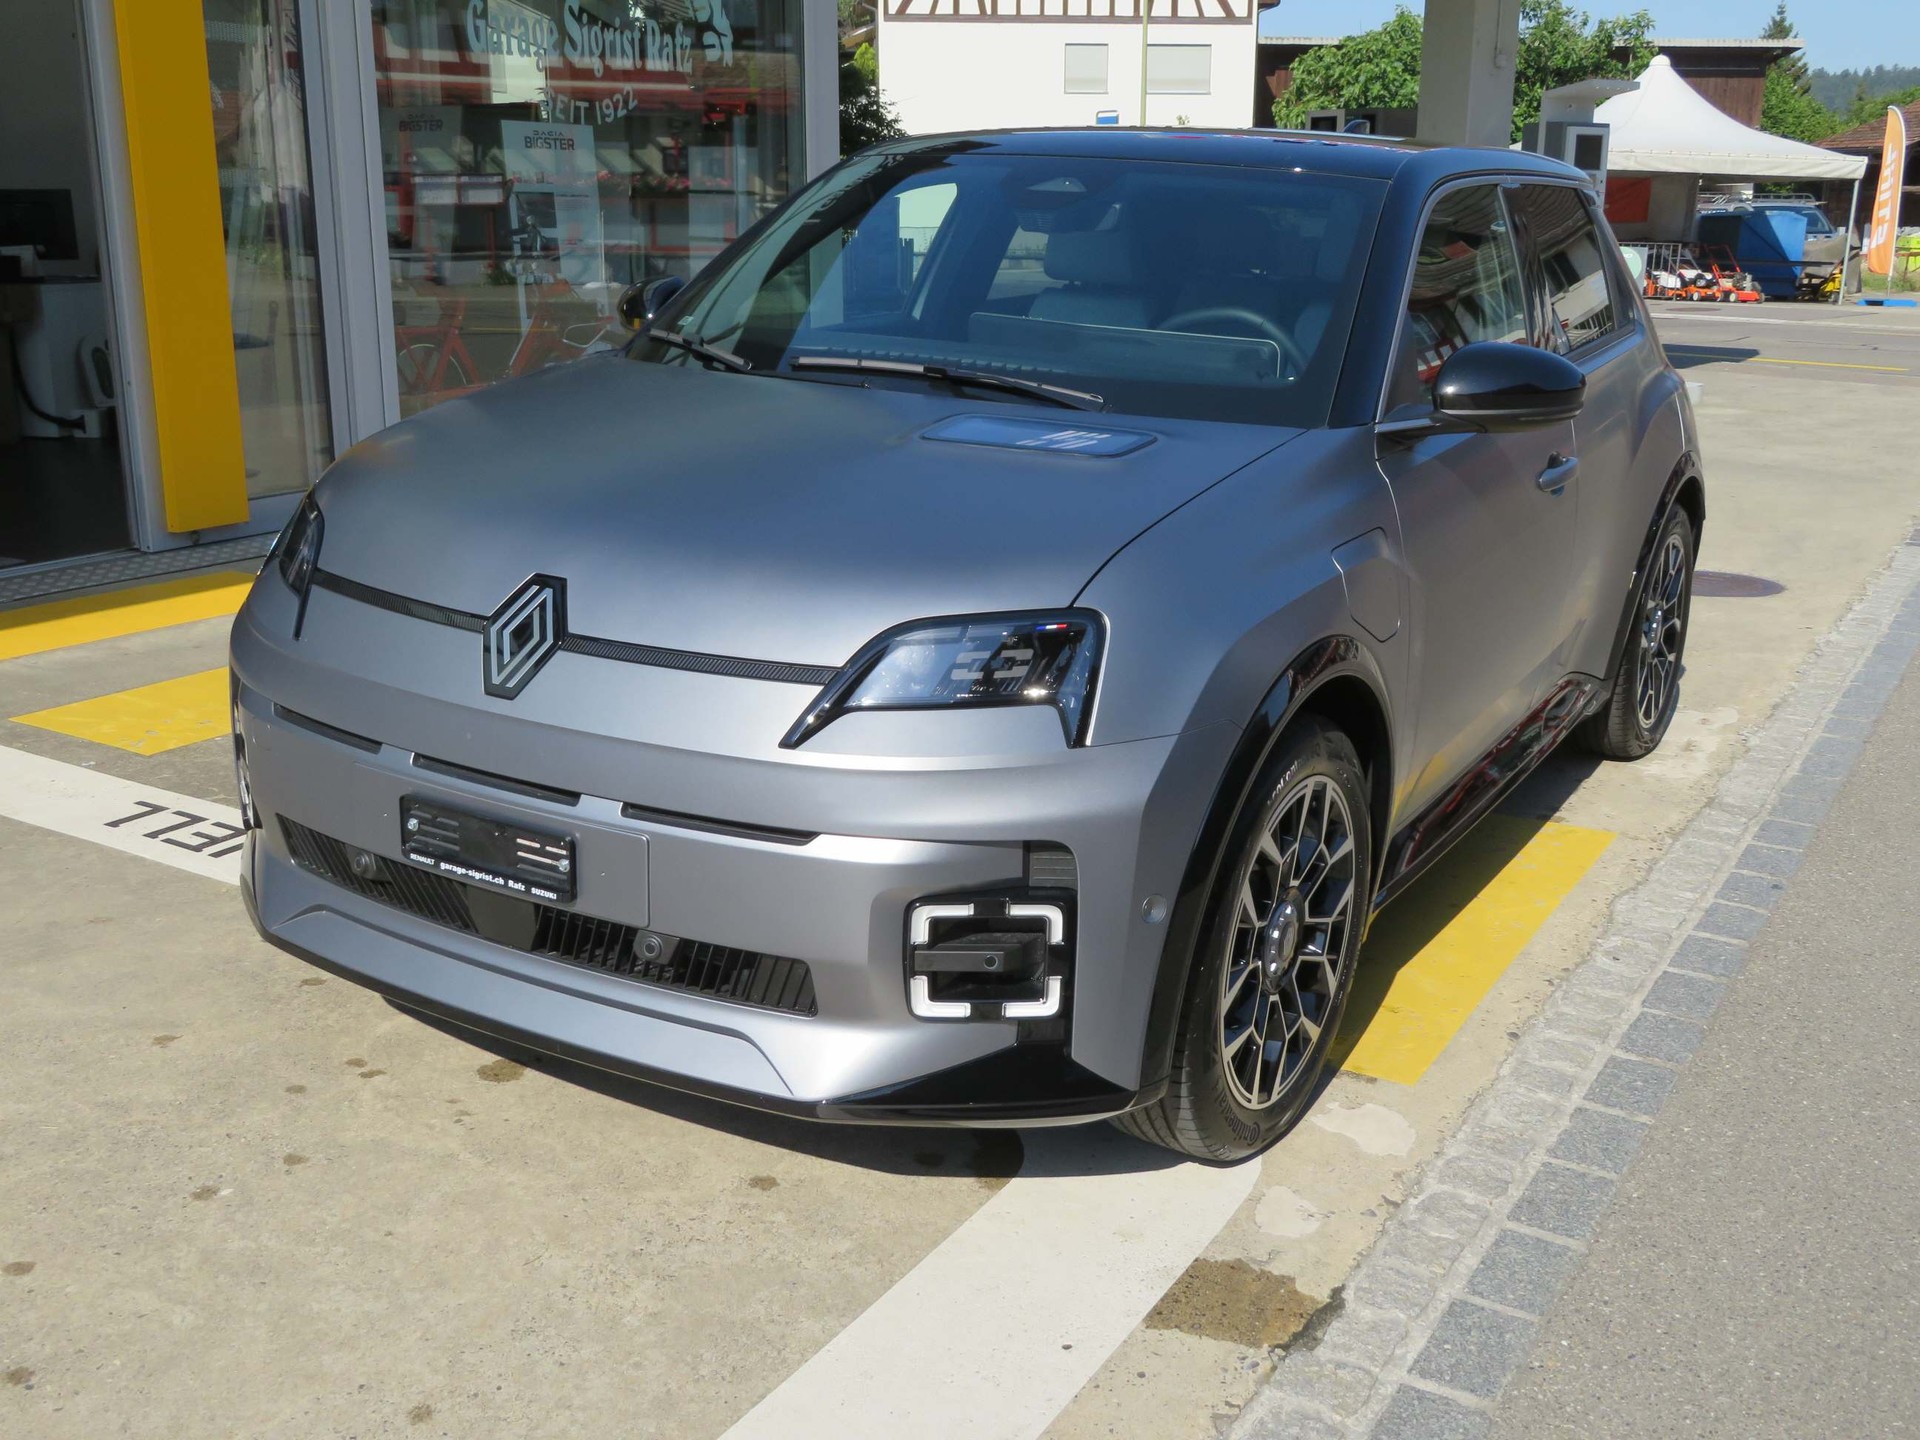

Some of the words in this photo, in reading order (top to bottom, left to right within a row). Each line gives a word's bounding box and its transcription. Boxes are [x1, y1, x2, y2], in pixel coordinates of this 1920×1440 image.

[466, 1, 558, 72] Garage
[564, 0, 643, 77] Sigrist
[646, 18, 693, 74] Rafz
[398, 119, 444, 132] BIGSTER
[544, 86, 592, 126] SEIT
[595, 84, 639, 126] 1922
[523, 136, 576, 151] BIGSTER
[409, 852, 436, 866] RENAULT
[440, 861, 505, 886] garage-sigrist.ch
[508, 879, 526, 891] Rafz
[530, 886, 558, 900] SUZUKI
